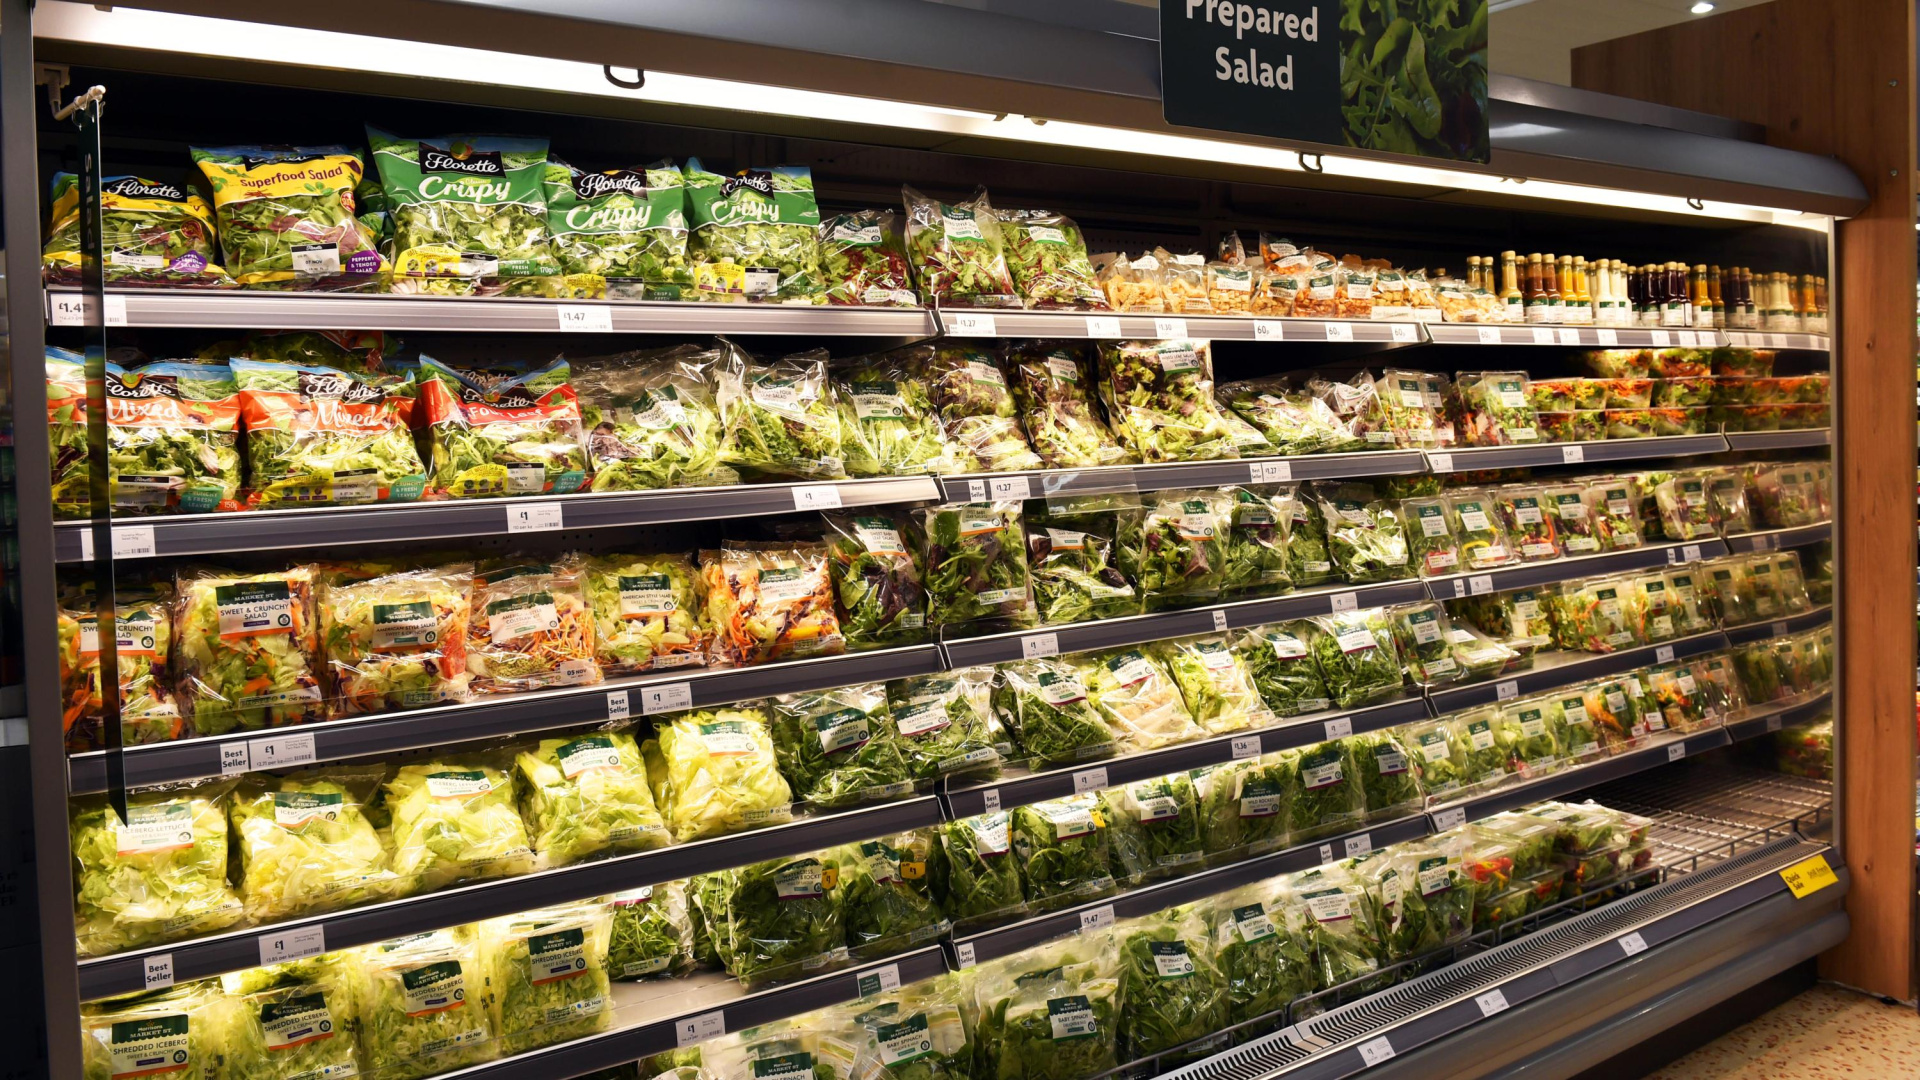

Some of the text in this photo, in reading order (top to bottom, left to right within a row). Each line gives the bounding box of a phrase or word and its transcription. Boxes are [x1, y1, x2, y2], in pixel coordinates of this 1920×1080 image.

[1186, 0, 1318, 42] Prepared
[1216, 47, 1294, 90] Salad
[424, 153, 500, 174] Florette
[240, 166, 344, 189] Superfood Salad
[107, 178, 183, 200] Florette
[418, 176, 511, 202] Crispy
[579, 173, 642, 197] Florette
[710, 200, 780, 222] Crispy
[566, 204, 652, 230] Crispy
[564, 312, 586, 321] £1.47
[960, 319, 976, 328] £1.27
[1257, 325, 1270, 336] 60p
[1328, 326, 1340, 336] 60p
[310, 401, 377, 427] Mixed
[996, 484, 1011, 492] £1.27
[520, 512, 528, 520] £1
[220, 607, 244, 616] SWEET
[254, 604, 289, 612] CRUNCHY
[654, 693, 660, 702] £1
[830, 724, 859, 736] WATERCRESS
[265, 746, 274, 755] £1
[222, 759, 246, 768] Seller
[564, 756, 588, 764] ICEBERG
[122, 822, 188, 834] ICEBERG LETTUCE
[1786, 872, 1800, 884] Quick
[1792, 882, 1804, 890] Sale
[1084, 914, 1098, 924] £1.47
[274, 940, 284, 951] £1
[542, 942, 564, 950] MARKET
[532, 949, 584, 965] SHREDDED ICEBERG
[960, 956, 974, 964] Seller
[148, 962, 168, 974] Best
[146, 972, 172, 983] Seller
[412, 974, 438, 987] MARKET
[436, 978, 463, 990] ICEBERG
[264, 1011, 328, 1032] SHREDDED ICEBERG
[130, 1030, 162, 1038] MARKET
[688, 1024, 694, 1033] £1
[890, 1029, 911, 1038] MARKET
[900, 1034, 923, 1045] SPINACH
[112, 1038, 188, 1056] SHREDDED ICEBERG
[148, 1048, 175, 1057] CRUNCHY
